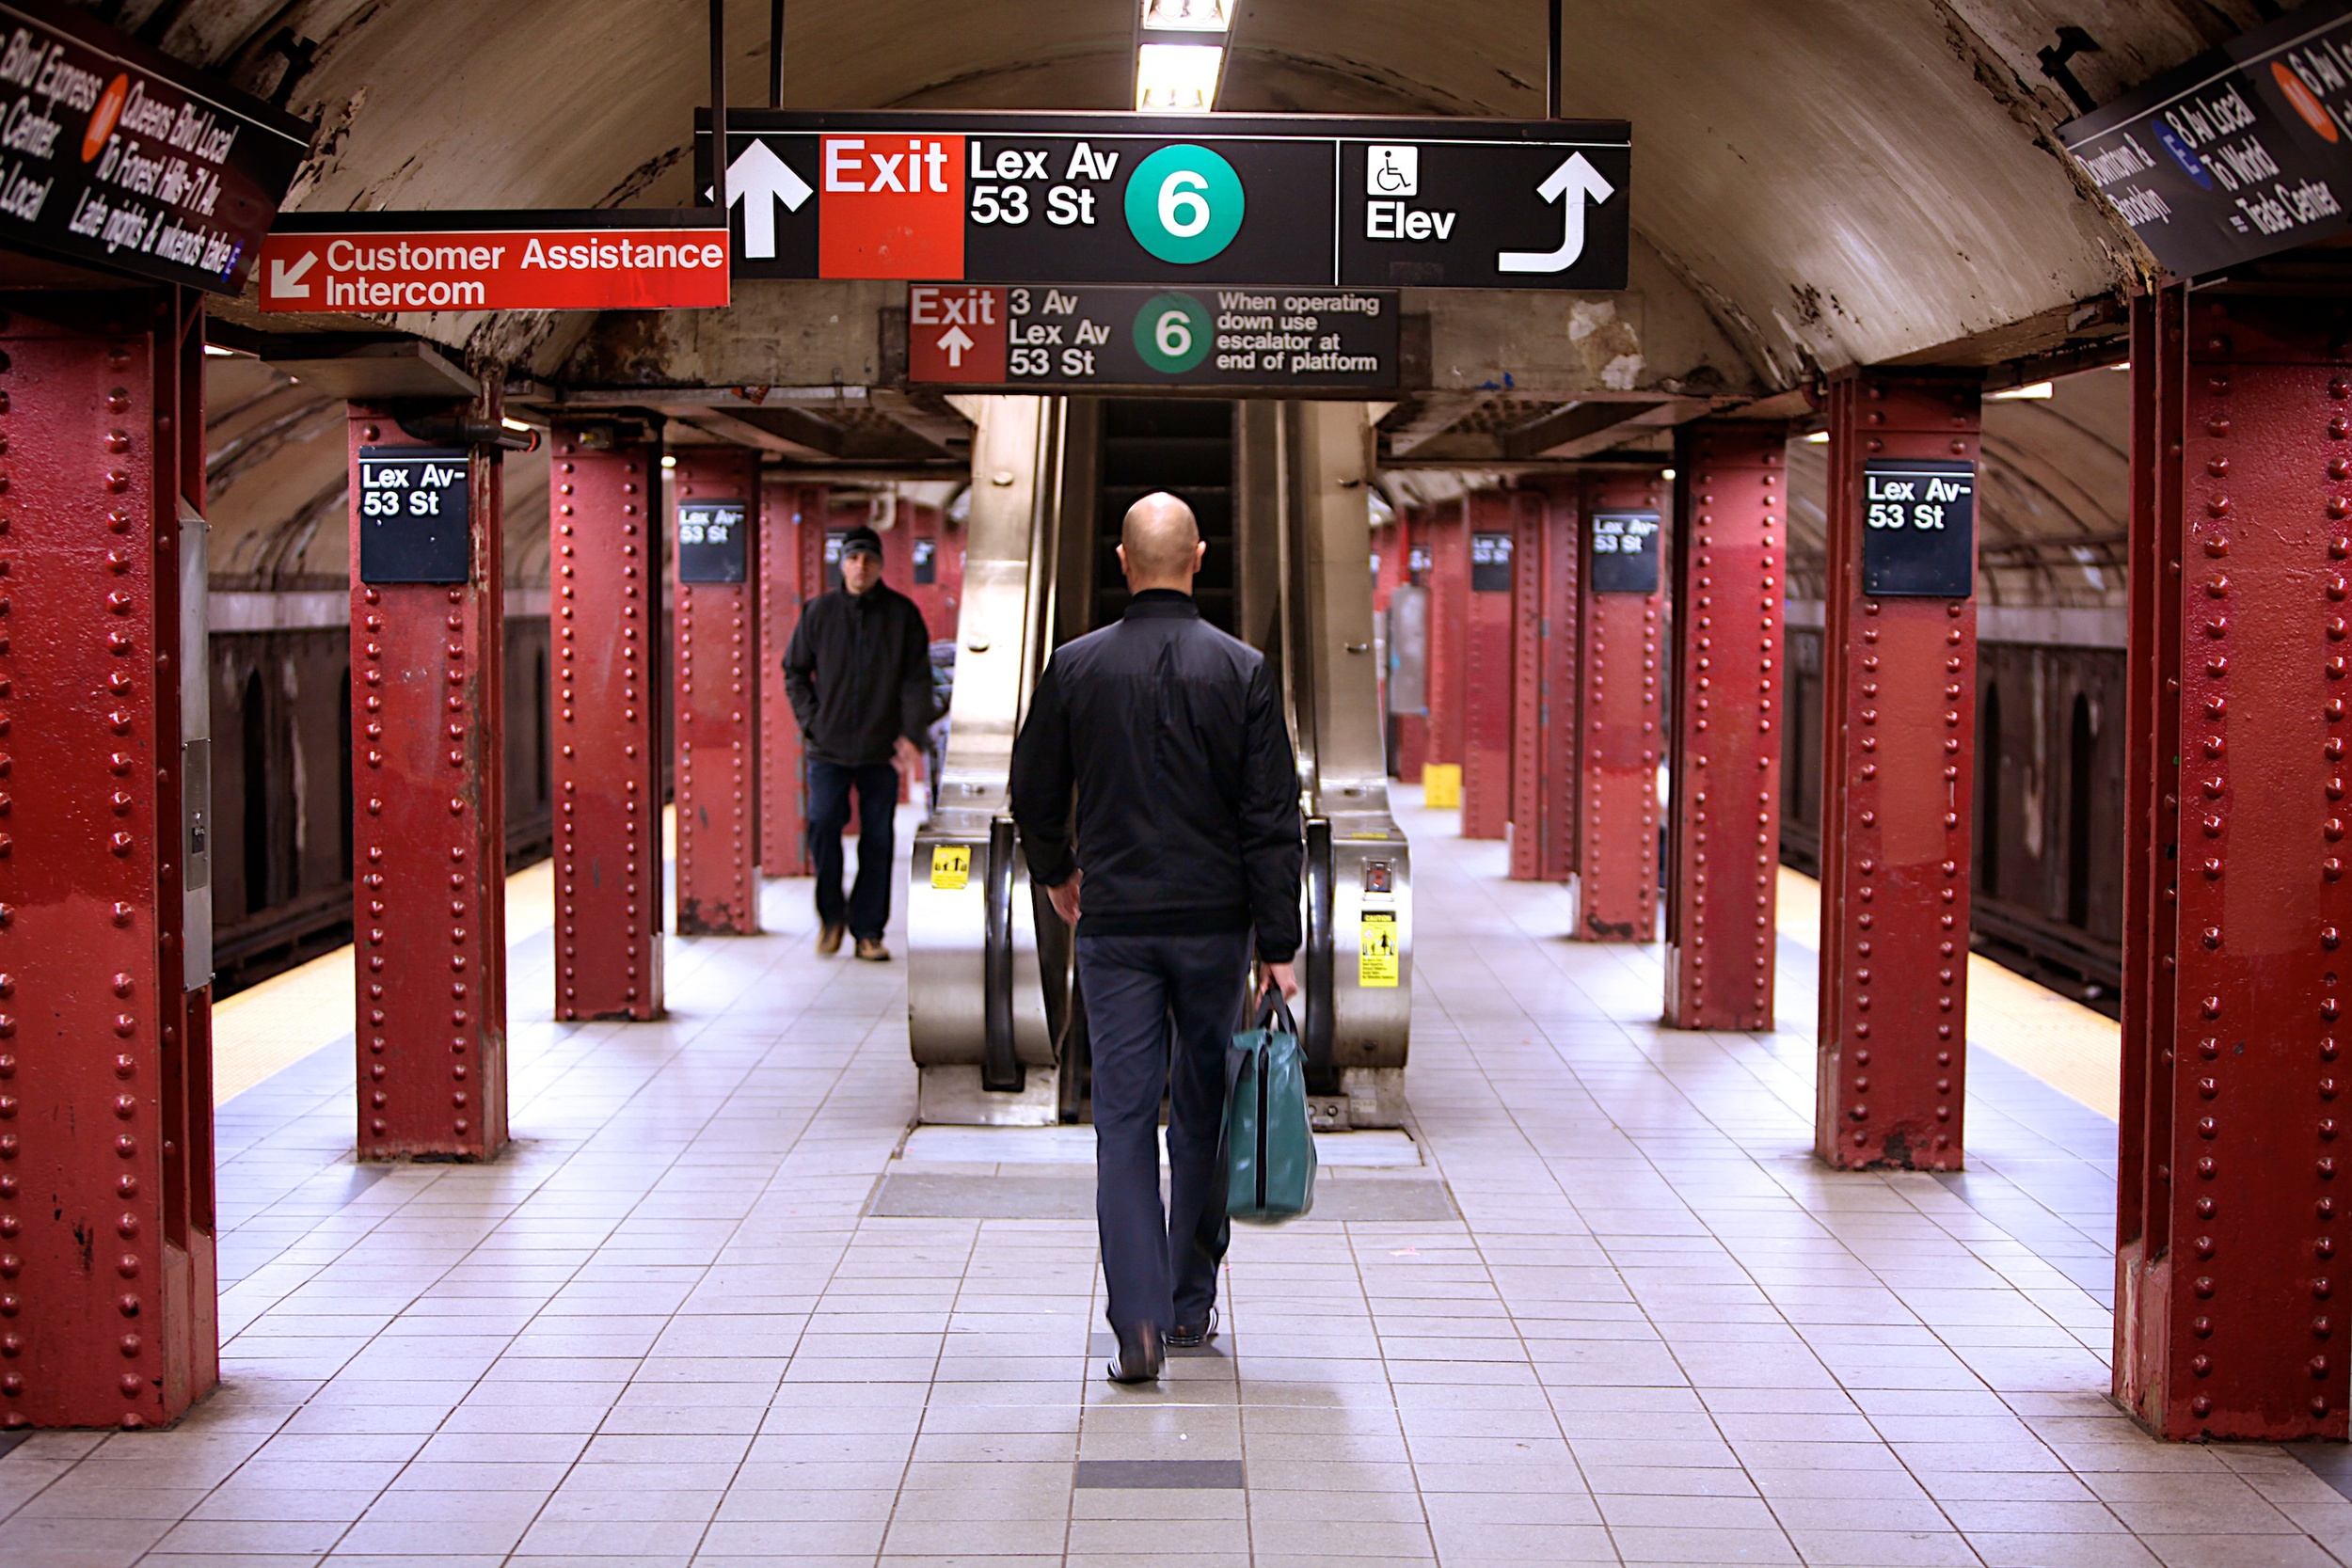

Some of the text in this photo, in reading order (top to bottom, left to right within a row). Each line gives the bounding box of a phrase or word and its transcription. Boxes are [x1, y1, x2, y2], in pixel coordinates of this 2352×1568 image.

[35, 44, 103, 113] Express
[2288, 52, 2325, 97] 6
[2303, 46, 2346, 91] Av
[2, 94, 62, 160] Center.
[119, 80, 240, 165] Queens Blvd Local
[2165, 81, 2258, 150] 8 Av Local
[95, 133, 121, 182] To
[112, 140, 167, 196] Forest
[826, 138, 948, 193] Exit
[970, 141, 1119, 181] Lex Av
[2074, 132, 2157, 188] Downtown &
[2163, 135, 2201, 175] E
[2200, 134, 2281, 192] To World
[0, 160, 54, 222] Local
[970, 185, 1095, 226] 53 St
[1157, 169, 1211, 238] 6
[2106, 183, 2172, 227] Brooklyn
[2235, 177, 2344, 235] Trade Center
[69, 185, 109, 237] Late
[100, 198, 149, 254] nights
[141, 210, 165, 253] &
[199, 230, 232, 274] take
[1367, 200, 1456, 240] Elev
[326, 237, 723, 272] Customer Assistance
[326, 276, 485, 307] Intercom
[911, 288, 995, 325] Exit
[1009, 288, 1078, 315] 3 Av
[1216, 291, 1381, 316] When operating
[1009, 318, 1111, 345] Lex Av
[1154, 309, 1192, 356] 6
[1216, 312, 1319, 332] down use
[1216, 332, 1342, 352] escalator at
[1009, 348, 1095, 376] 53 St
[1216, 352, 1378, 374] end of platform
[363, 464, 466, 488] Lex Av-
[1868, 476, 1972, 502] Lex Av-
[363, 490, 439, 516] 53 St
[679, 509, 709, 526] Lex
[1867, 503, 1945, 530] 53 St
[679, 525, 728, 544] 53 St
[1594, 518, 1624, 534] Lex
[1594, 534, 1644, 553] 53 St
